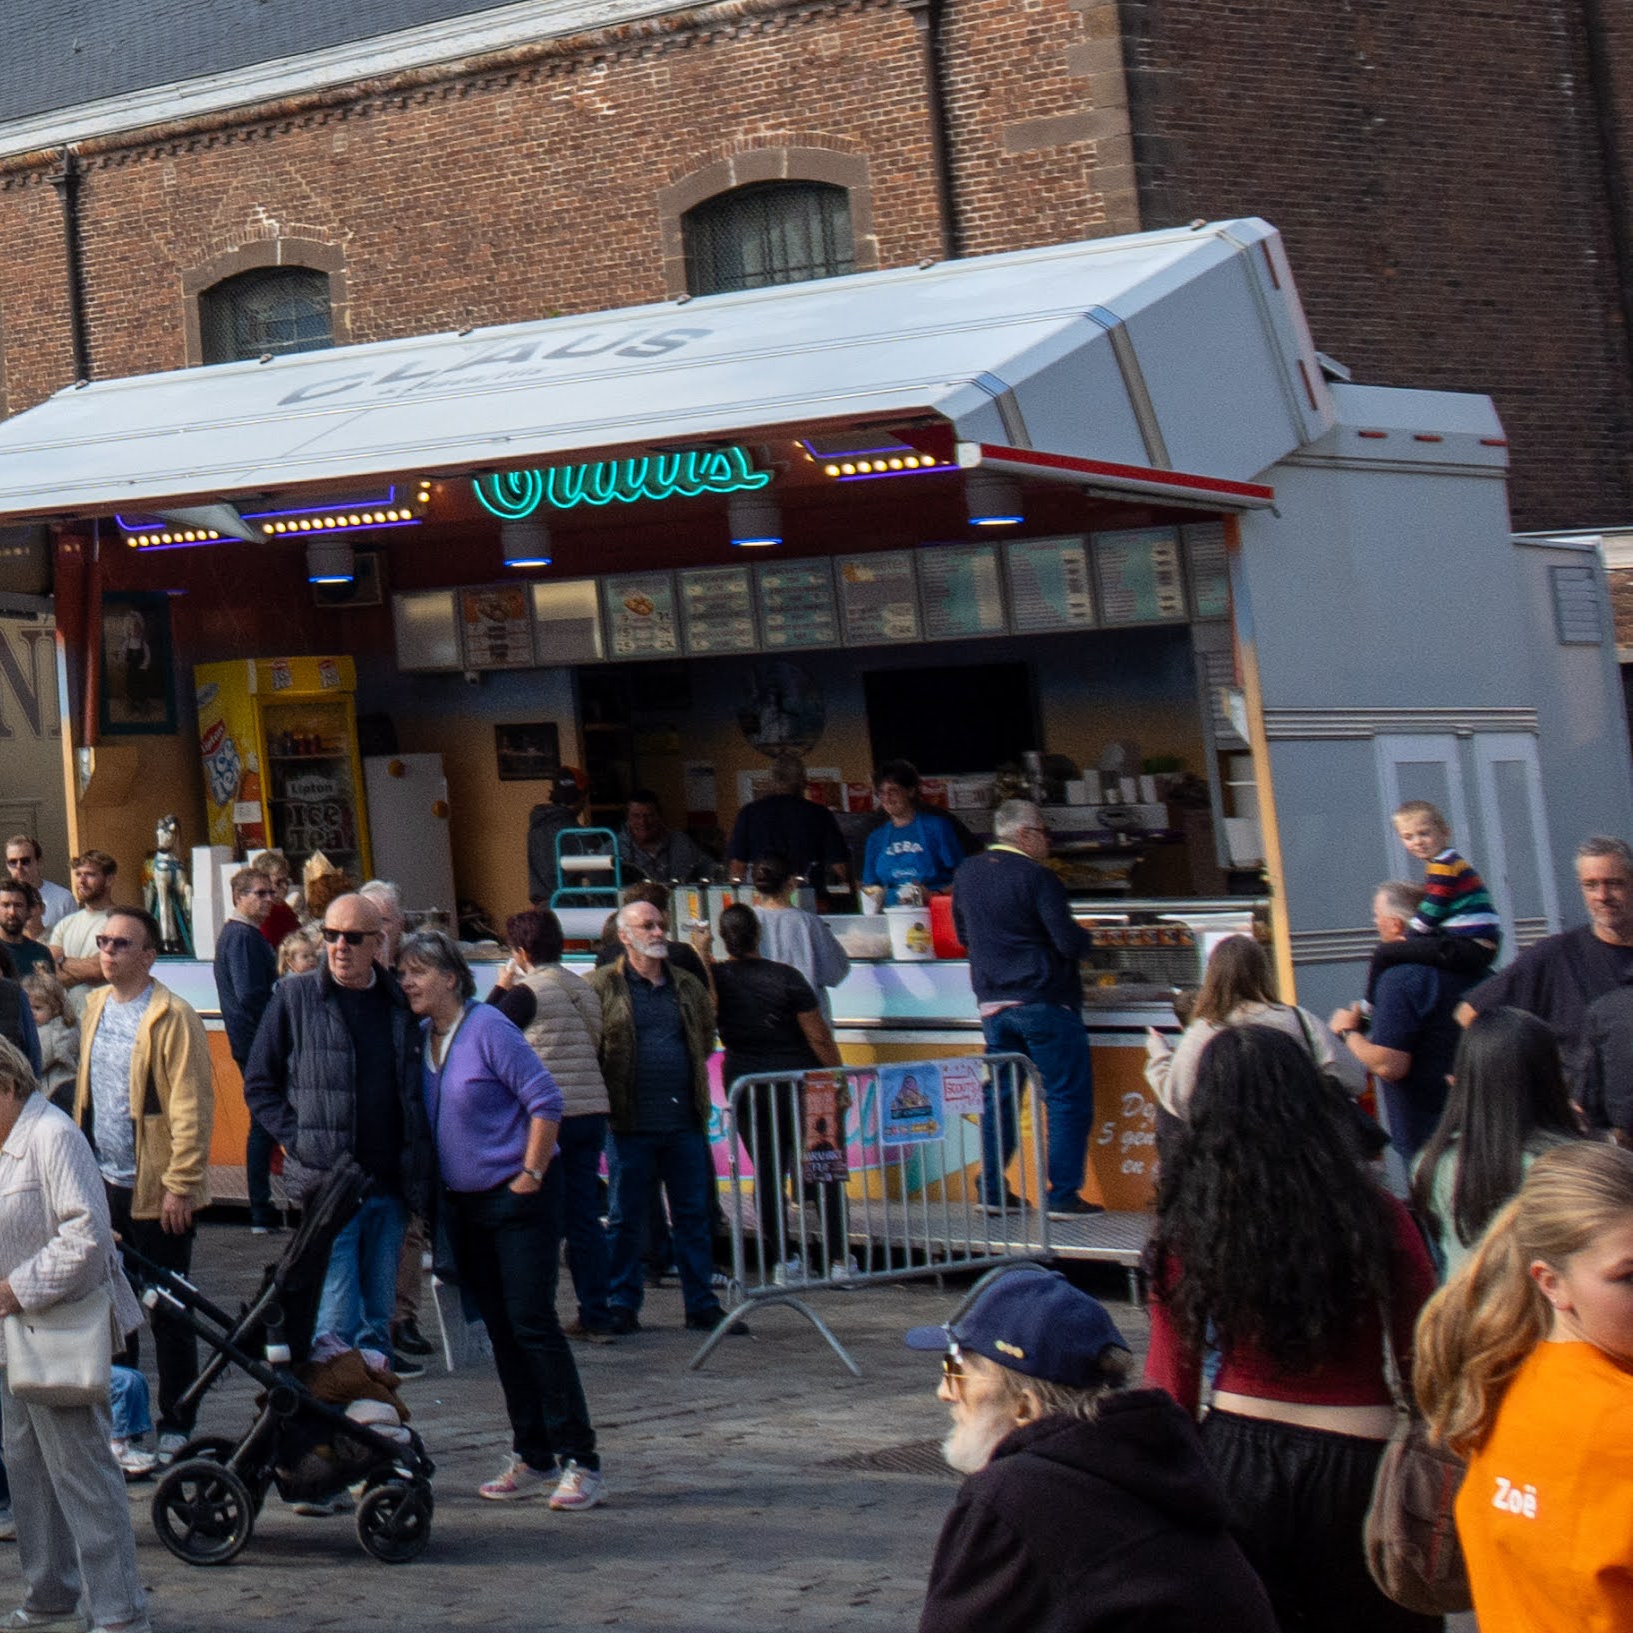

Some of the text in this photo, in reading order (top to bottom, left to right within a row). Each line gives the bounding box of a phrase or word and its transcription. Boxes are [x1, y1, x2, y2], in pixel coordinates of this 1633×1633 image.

[276, 326, 715, 406] CLAUS
[290, 780, 334, 797] Lipton
[1096, 1121, 1117, 1146] 5
[1492, 1475, 1537, 1520] Zoë
